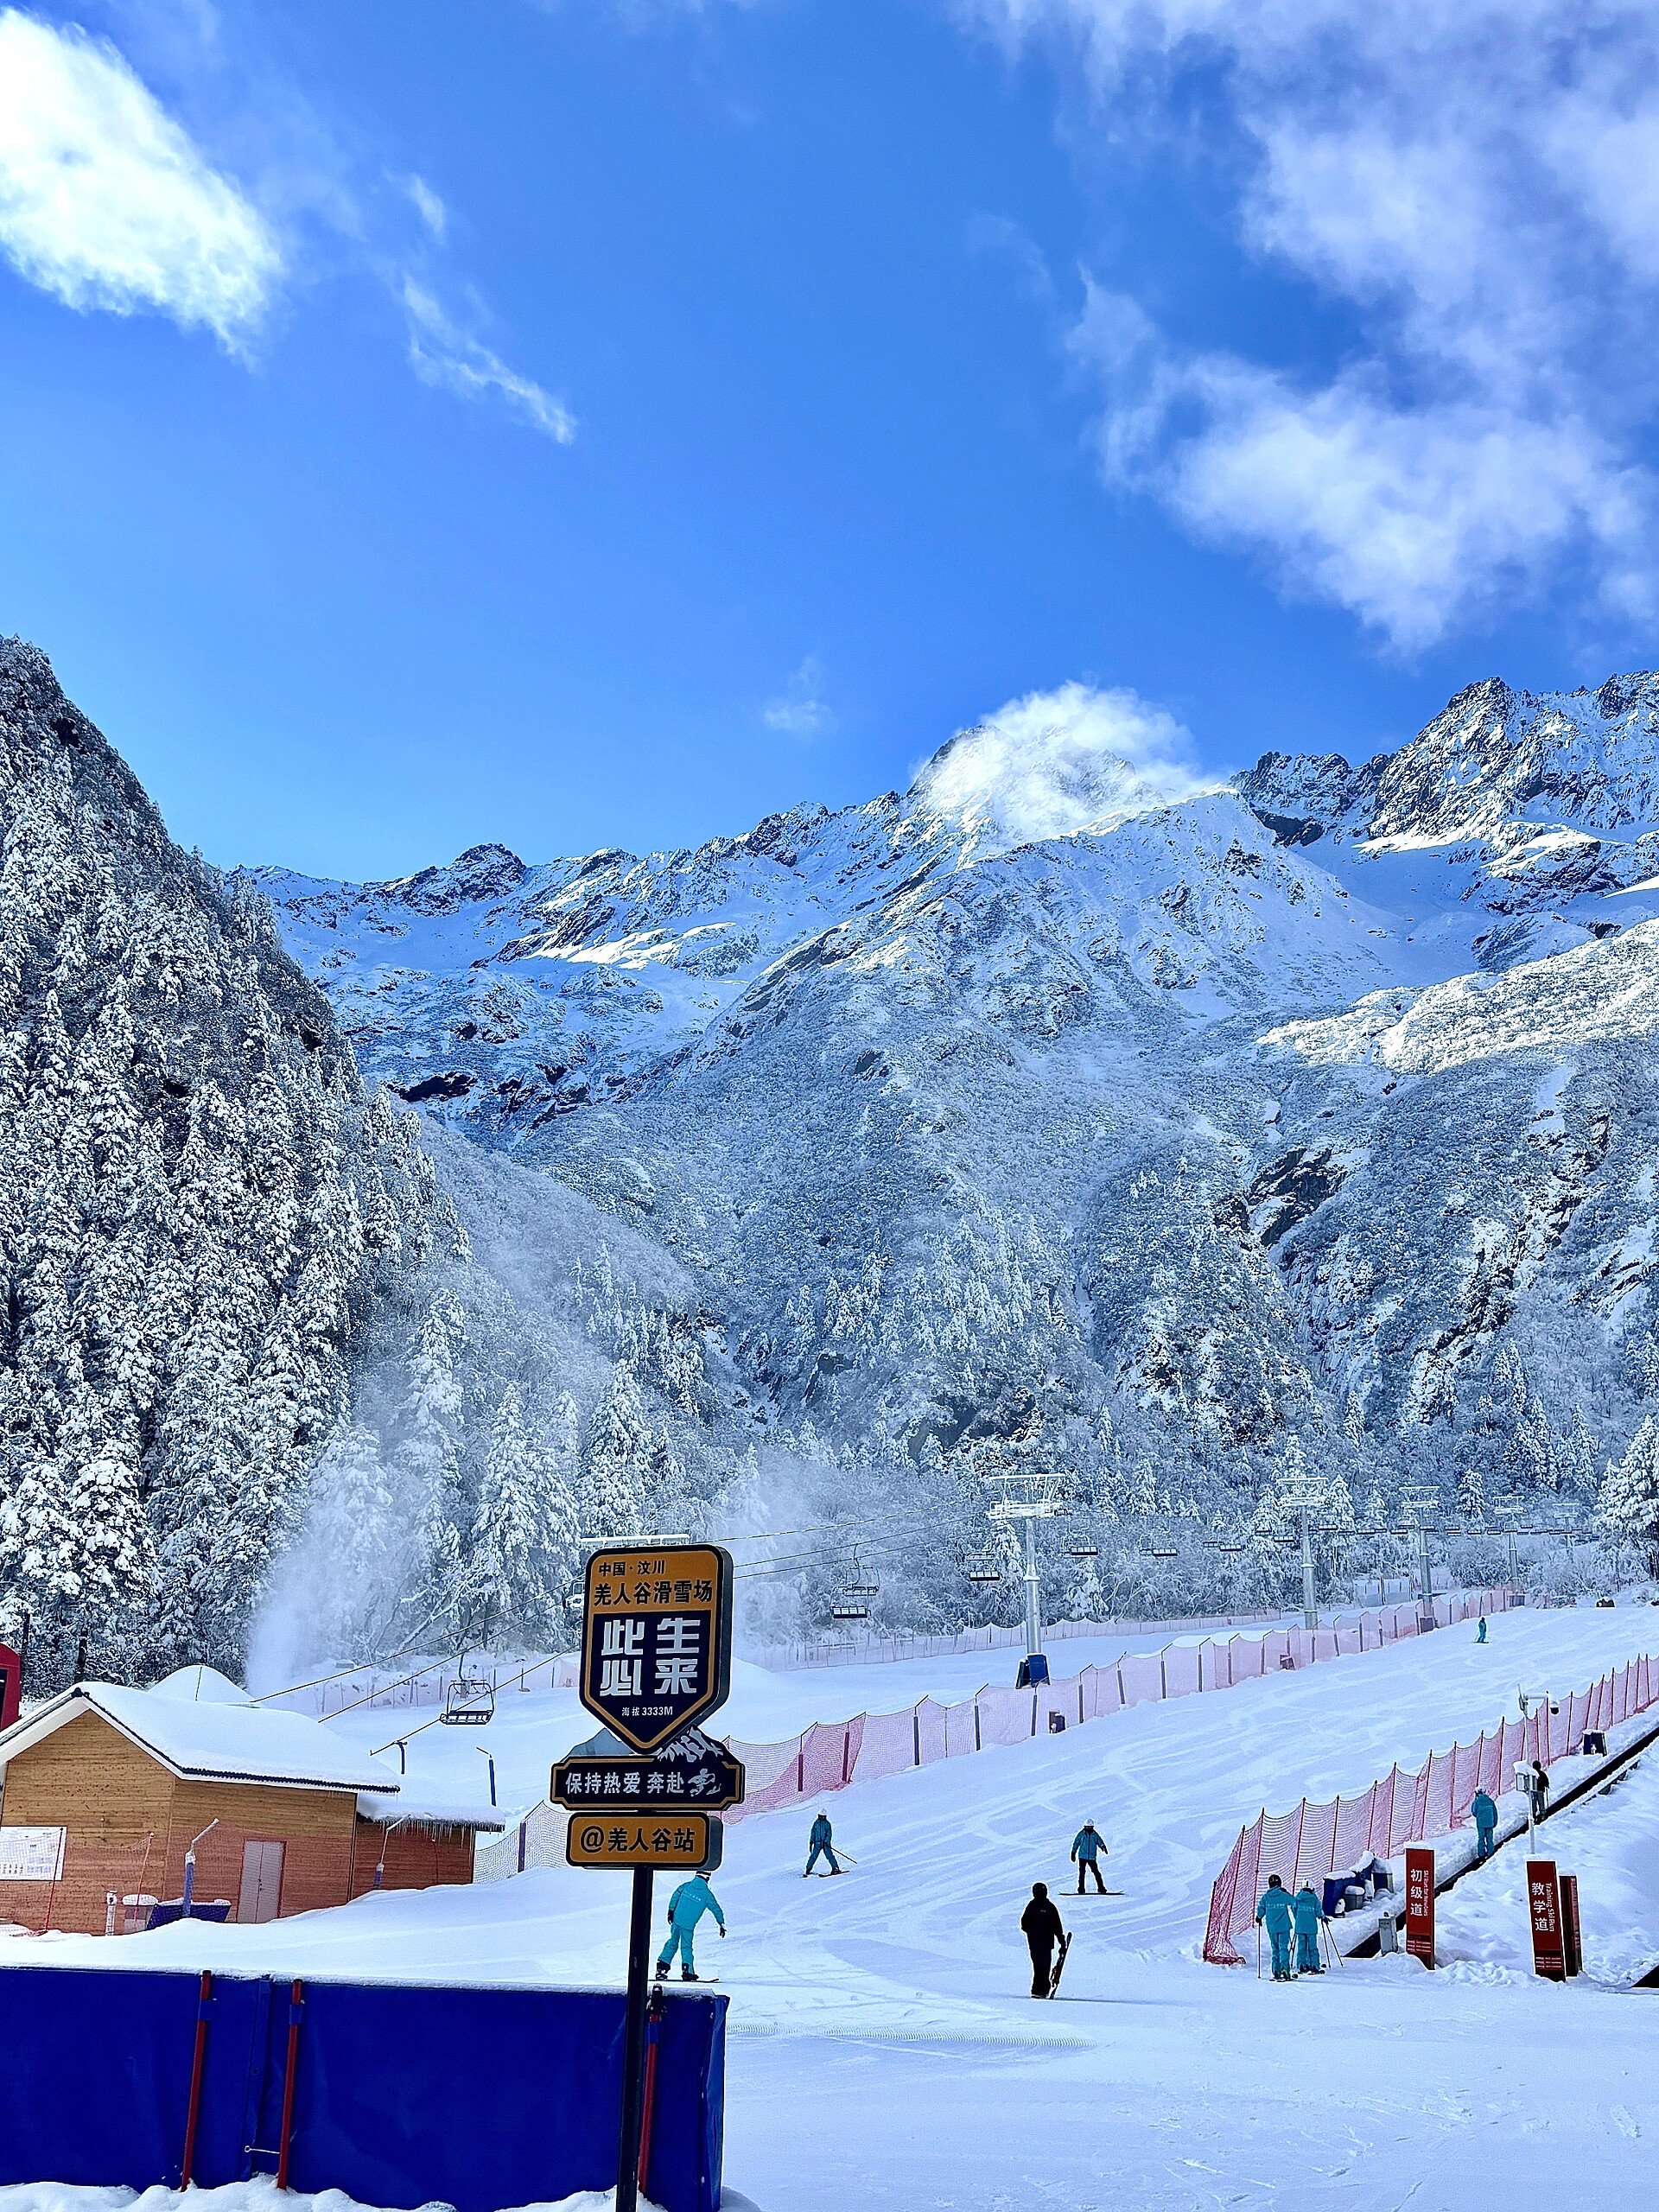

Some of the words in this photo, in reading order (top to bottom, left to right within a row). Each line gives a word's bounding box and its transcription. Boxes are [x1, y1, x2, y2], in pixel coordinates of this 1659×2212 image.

[599, 1560, 665, 1577] 中国·汶川
[594, 1580, 713, 1606] 羌人谷滑雪场
[601, 1618, 701, 1656] 此生
[600, 1658, 698, 1696] 必来
[565, 1772, 640, 1794] 保持热爱
[647, 1771, 685, 1794] 奔赴
[581, 1825, 696, 1853] @羌人谷站
[1410, 1869, 1423, 1916] 初级道
[1545, 1883, 1554, 1908] Training
[1532, 1883, 1548, 1931] 教学道
